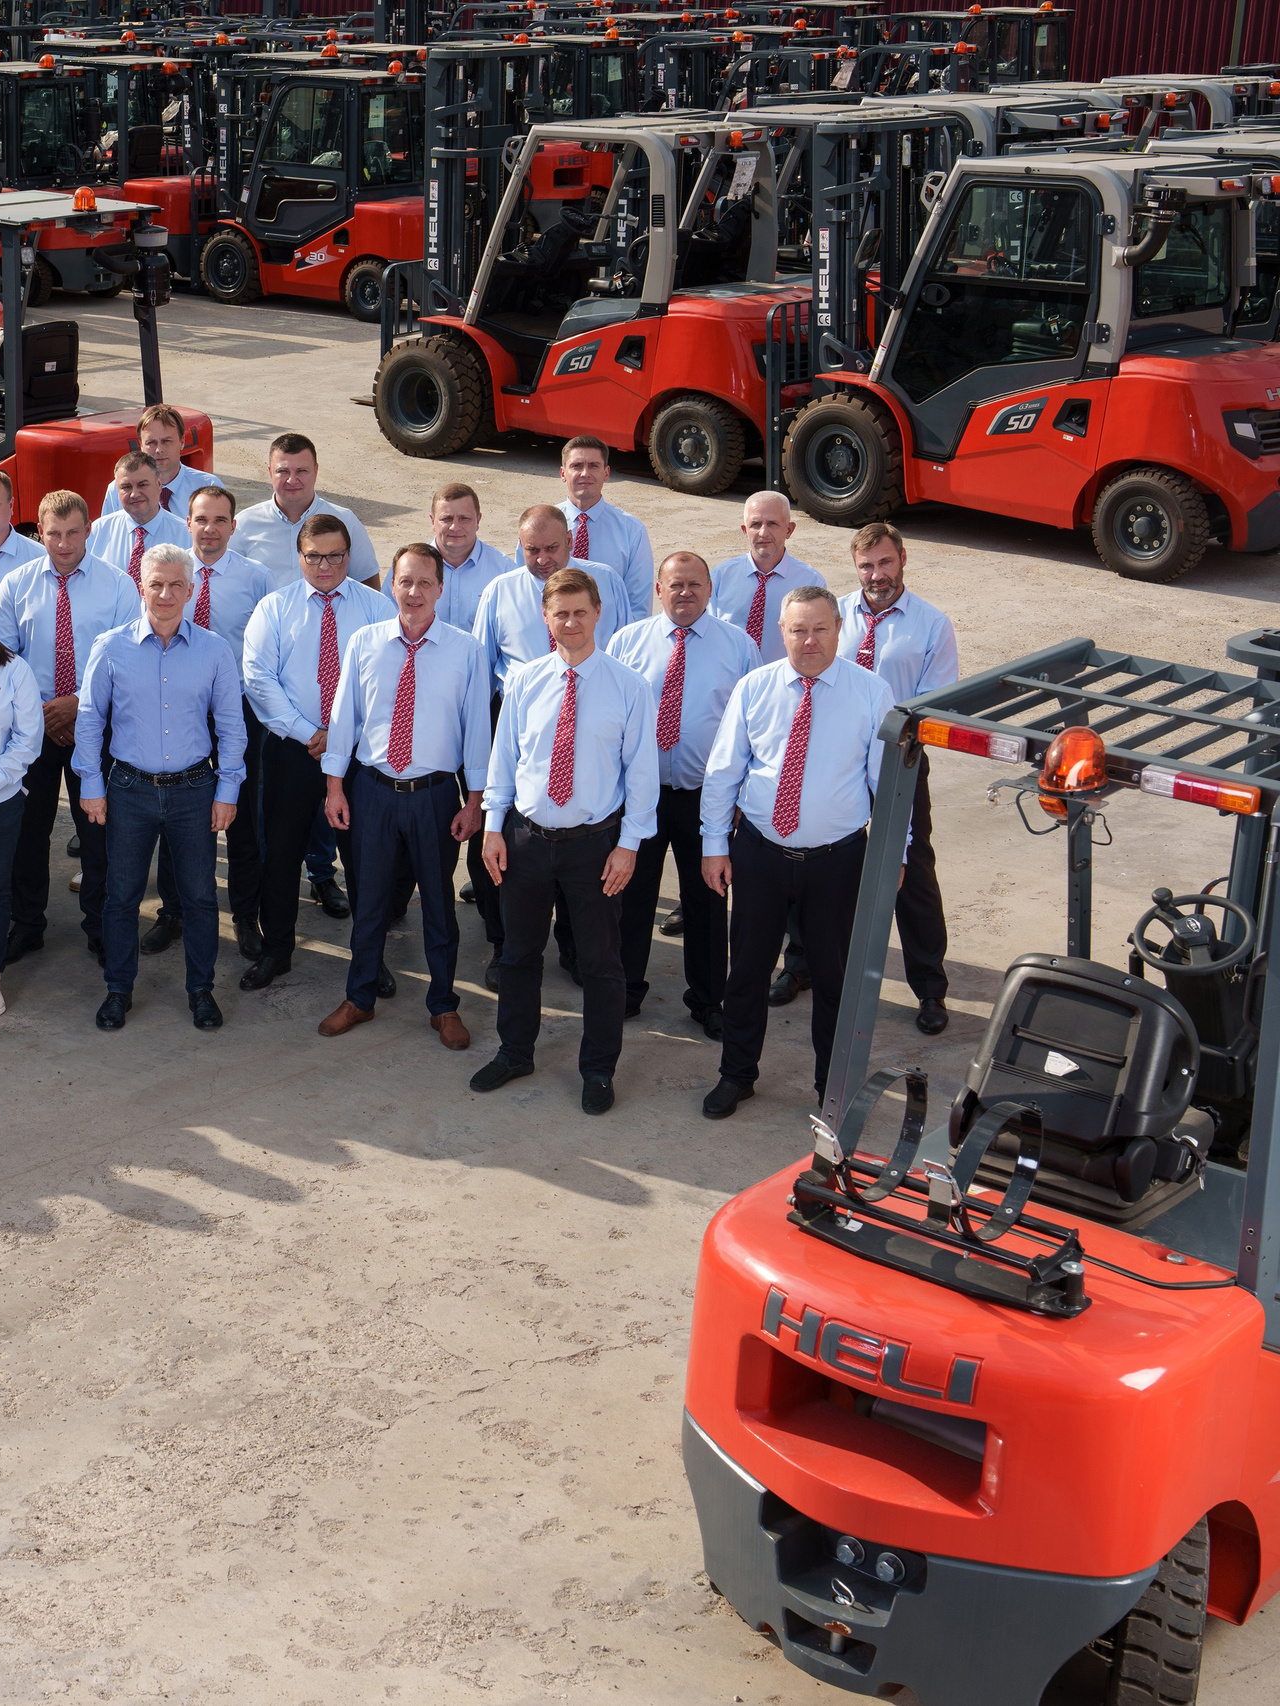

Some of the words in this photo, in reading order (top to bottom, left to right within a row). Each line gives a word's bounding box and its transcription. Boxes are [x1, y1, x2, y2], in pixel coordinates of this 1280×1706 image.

[219, 145, 227, 181] HELI
[428, 202, 438, 254] HELI
[617, 199, 628, 248] HELI
[309, 251, 325, 262] 30
[428, 259, 438, 269] CE
[818, 252, 830, 310] HELI
[818, 314, 830, 325] CE
[568, 354, 593, 372] 50
[1018, 403, 1029, 411] G3
[1004, 413, 1037, 432] 50
[761, 1285, 982, 1406] HELI
